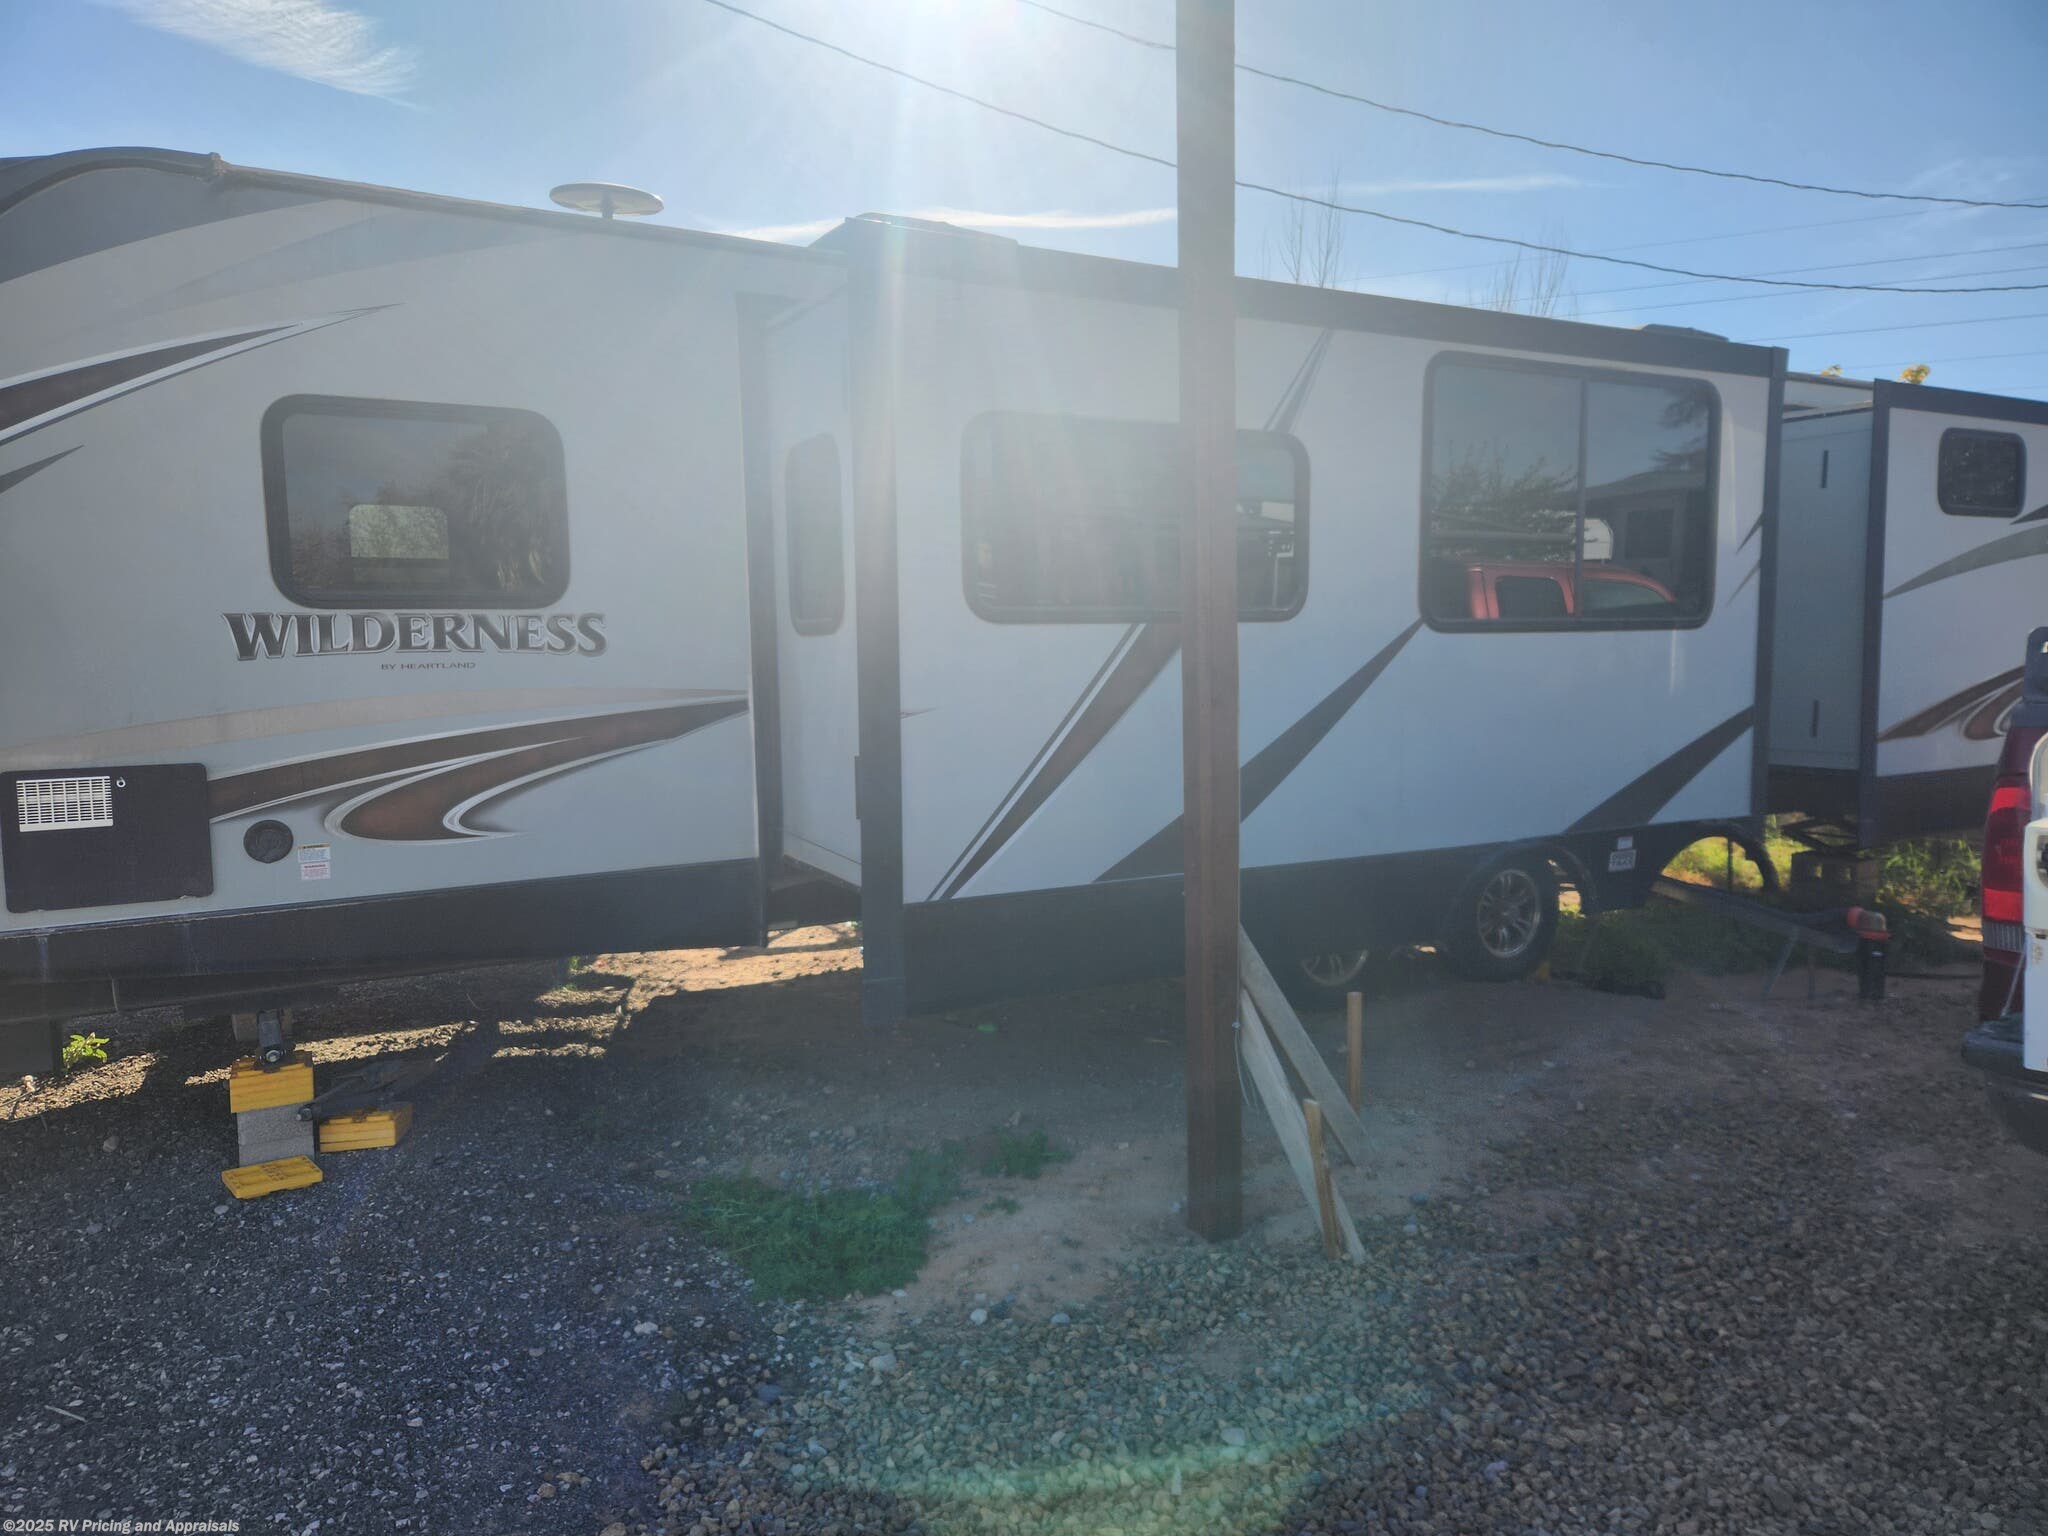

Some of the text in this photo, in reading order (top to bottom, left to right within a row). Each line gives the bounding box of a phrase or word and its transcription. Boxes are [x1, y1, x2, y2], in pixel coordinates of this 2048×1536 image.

[222, 611, 607, 661] WILDERNESS
[380, 661, 477, 671] BY HEARTLAND
